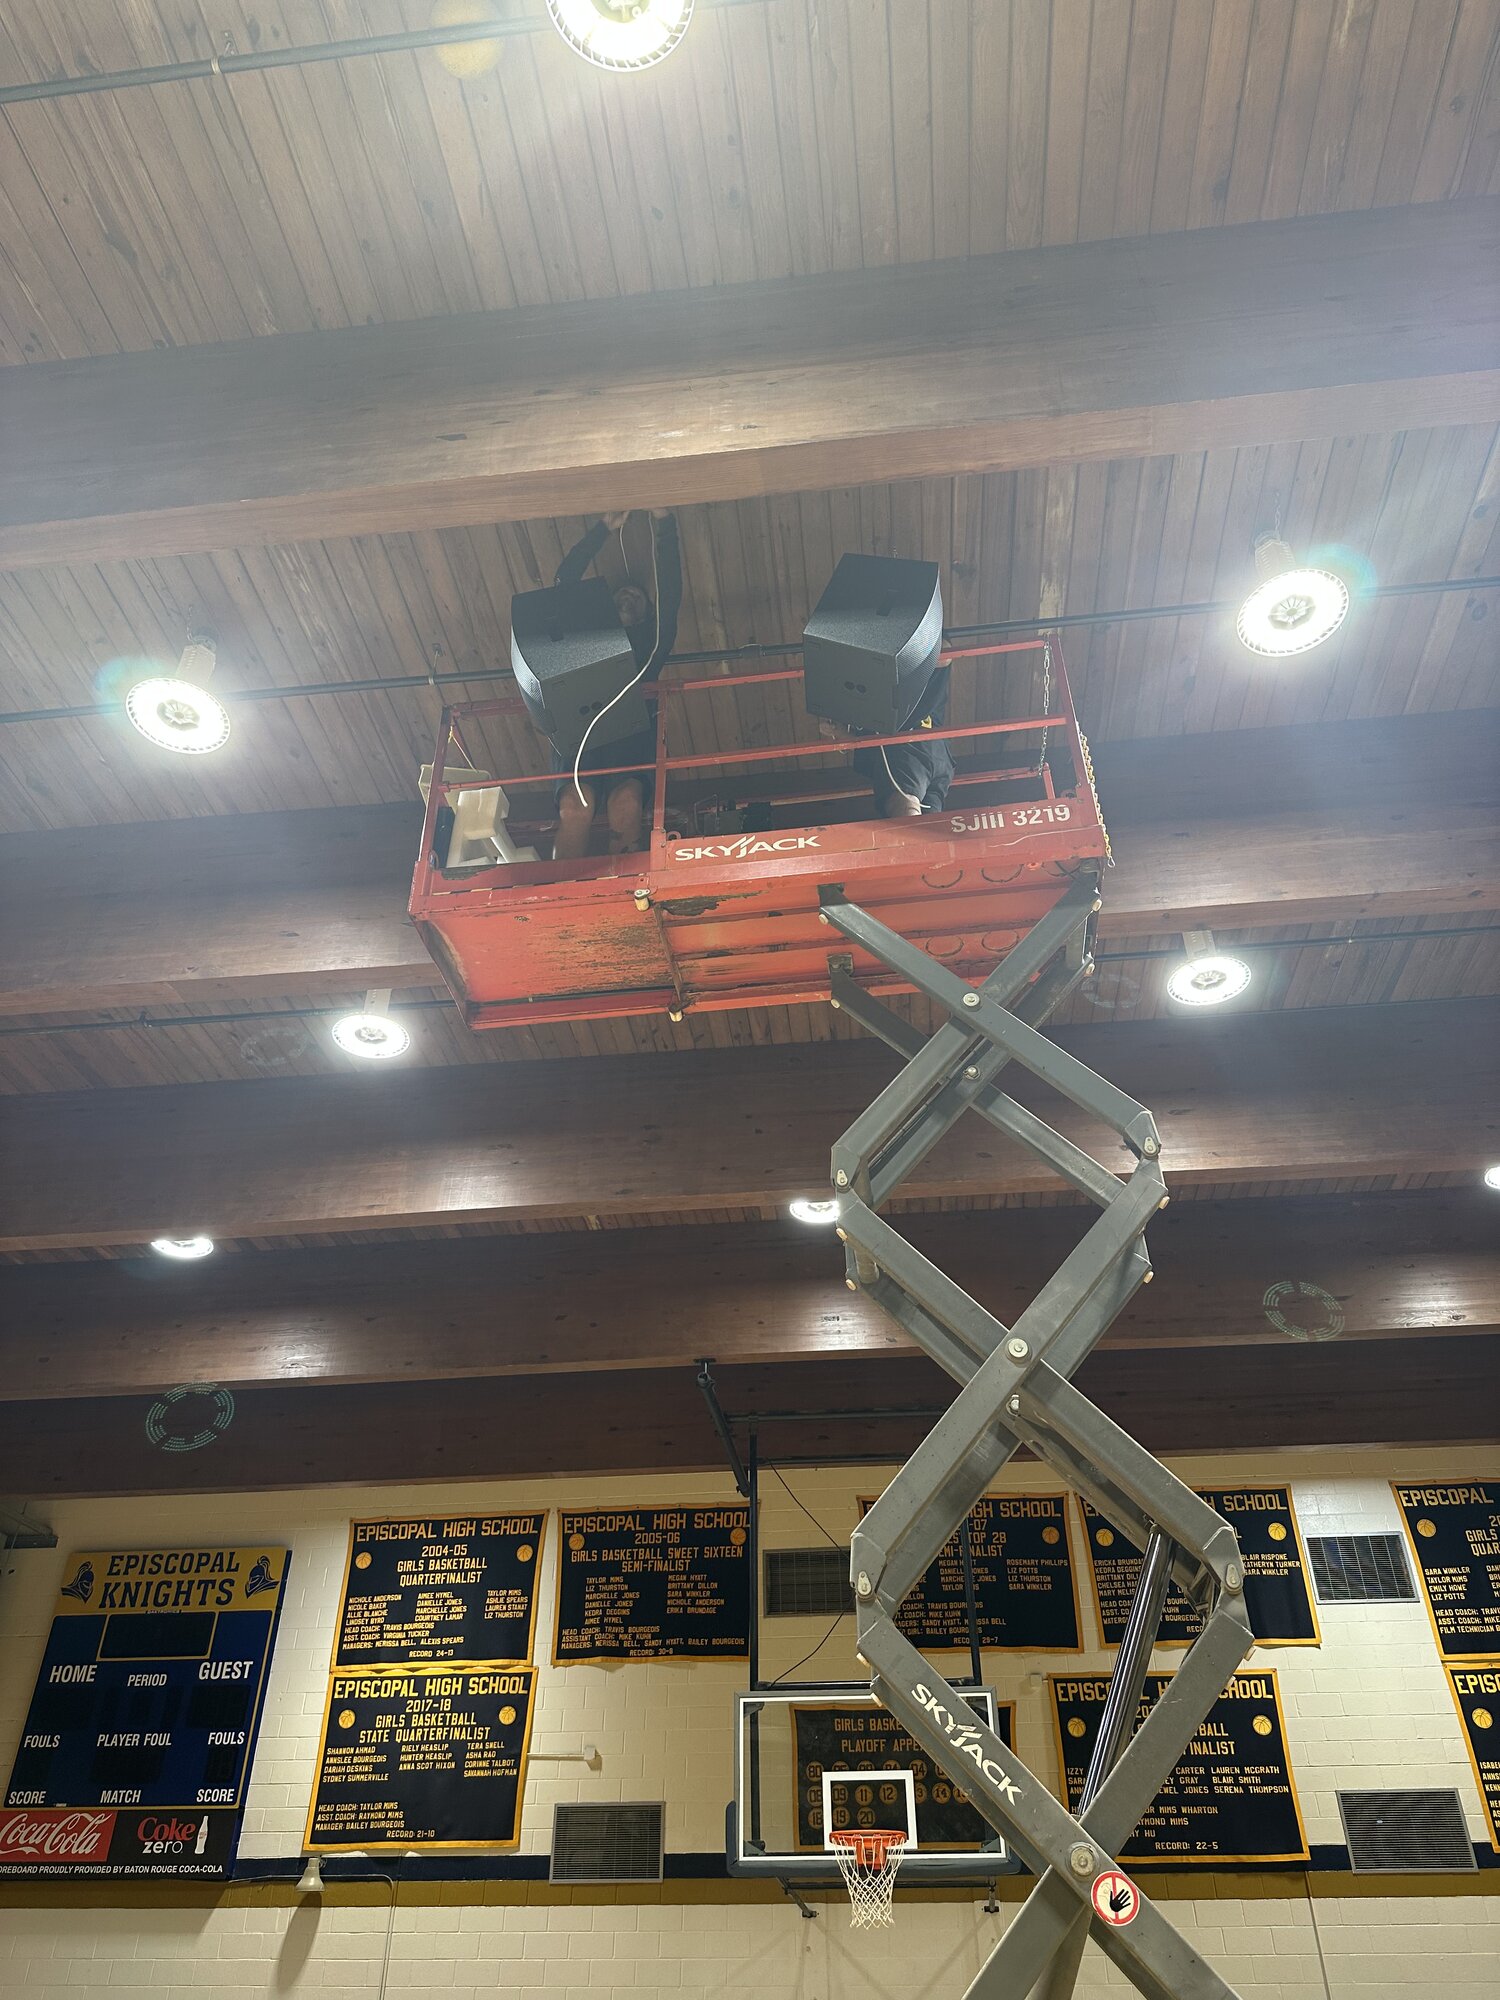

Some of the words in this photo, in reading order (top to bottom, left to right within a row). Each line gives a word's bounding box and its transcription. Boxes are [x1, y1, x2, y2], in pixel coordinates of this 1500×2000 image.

[1012, 804, 1071, 827] 3219
[675, 835, 822, 861] SKYJACK
[1224, 1493, 1288, 1512] SCHOOL
[1398, 1487, 1494, 1507] EPISCOPAL
[999, 1501, 1061, 1518] SCHOOL
[564, 1515, 645, 1534] EPISCOPAL
[653, 1513, 686, 1530] HIGH
[694, 1511, 750, 1529] SCHOOL
[356, 1523, 437, 1542] EPISCOPAL
[443, 1521, 476, 1538] HIGH
[481, 1518, 538, 1536] SCHOOL
[1465, 1529, 1498, 1542] GIRLS
[635, 1532, 680, 1545] 2005-06
[992, 1531, 1007, 1544] 28
[421, 1544, 468, 1557] 2004-05
[571, 1550, 597, 1562] GIRLS
[601, 1548, 664, 1561] BASKETBALL
[667, 1547, 699, 1559] SWEET
[703, 1546, 743, 1558] SIXTEEN
[107, 1552, 240, 1576] EPISCOPAL
[397, 1560, 424, 1572] GIRLS
[428, 1557, 487, 1571] BASKETBALL
[621, 1560, 691, 1573] SEMI-FINALIST
[1040, 1558, 1068, 1566] PHILLIPS
[400, 1572, 482, 1587] QUARTERFINALIST
[99, 1578, 235, 1608] KNIGHTS
[1431, 1593, 1442, 1601] LIZ
[1443, 1592, 1465, 1600] POTTS
[1435, 1609, 1453, 1617] HEAD
[1454, 1608, 1479, 1616] COACH:
[1438, 1617, 1457, 1625] ASST.
[1458, 1617, 1482, 1625] COACH:
[1440, 1626, 1456, 1634] FILM
[49, 1665, 97, 1683] HOME
[199, 1661, 253, 1680] GUEST
[127, 1674, 167, 1687] PERIOD
[334, 1678, 419, 1699] EPISCOPAL
[425, 1677, 462, 1696] HIGH
[468, 1676, 529, 1696] SCHOOL
[405, 1699, 452, 1713] 2017-18
[375, 1714, 406, 1728] GIRLS
[411, 1713, 477, 1727] BASKETBALL
[834, 1718, 864, 1732] GIRLS
[24, 1735, 60, 1748] FOULS
[97, 1734, 140, 1748] PLAYER
[144, 1733, 171, 1746] FOUL
[208, 1731, 245, 1745] FOULS
[359, 1729, 391, 1744] STATE
[395, 1727, 491, 1742] QUARTERFINALIST
[420, 1743, 449, 1751] HEASLIP
[467, 1742, 483, 1750] TERA
[841, 1739, 886, 1753] PLAYOFF
[911, 1683, 1022, 1807] SKYJACK
[424, 1752, 453, 1761] HEASLIP
[1067, 1767, 1084, 1775] IZZY
[1176, 1767, 1204, 1775] CARTER
[1211, 1766, 1240, 1774] LAUREN
[1213, 1776, 1234, 1784] BLAIR
[1238, 1776, 1261, 1784] SMITH
[196, 1788, 235, 1802] SCORE
[883, 1787, 894, 1800] 12
[1183, 1786, 1209, 1794] JONES
[1214, 1786, 1244, 1794] SERENA
[1248, 1785, 1289, 1794] THOMPSON
[9, 1791, 46, 1804] SCORE
[100, 1790, 141, 1803] MATCH
[318, 1804, 335, 1812] HEAD
[336, 1803, 359, 1811] COACH:
[360, 1802, 383, 1811] TAYLOR
[1181, 1806, 1218, 1814] WHARTON
[334, 1812, 358, 1820] COACH:
[137, 1817, 197, 1841] Coke
[346, 1821, 369, 1829] BAILEY
[0, 1813, 112, 1855] Coca-Cola
[386, 1829, 415, 1838] RECORD:
[142, 1840, 183, 1854] zero
[1155, 1841, 1190, 1850] RECORD:
[1196, 1841, 1218, 1849] 22-5
[0, 1866, 38, 1874] OREBOARD
[39, 1866, 74, 1874] PROUDLY
[75, 1865, 112, 1873] PROVIDED
[114, 1865, 123, 1873] BY
[124, 1865, 149, 1873] BATON
[151, 1865, 177, 1873] ROUGE
[178, 1865, 223, 1873] COCA-COLA
